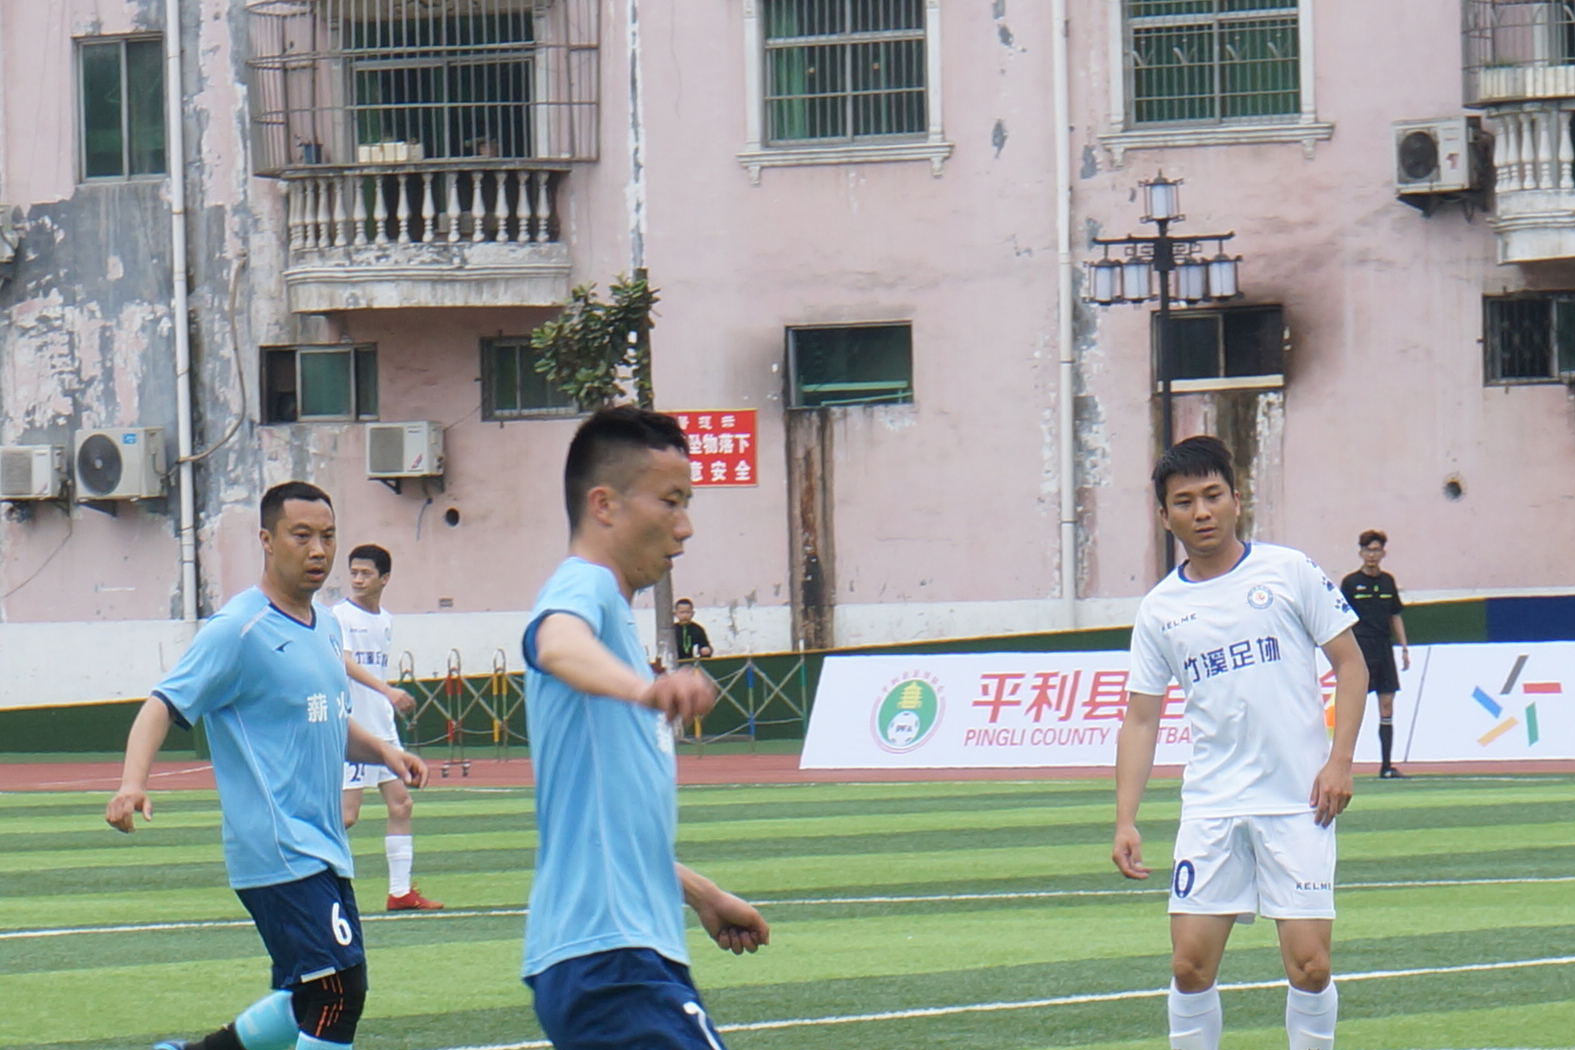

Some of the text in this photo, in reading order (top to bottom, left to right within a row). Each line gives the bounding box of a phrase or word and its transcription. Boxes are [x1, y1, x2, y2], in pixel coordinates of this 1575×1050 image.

[690, 459, 751, 482] 意安全
[963, 728, 1026, 747] PINGLI
[1030, 726, 1111, 746] COUNTY
[331, 901, 353, 946] 6
